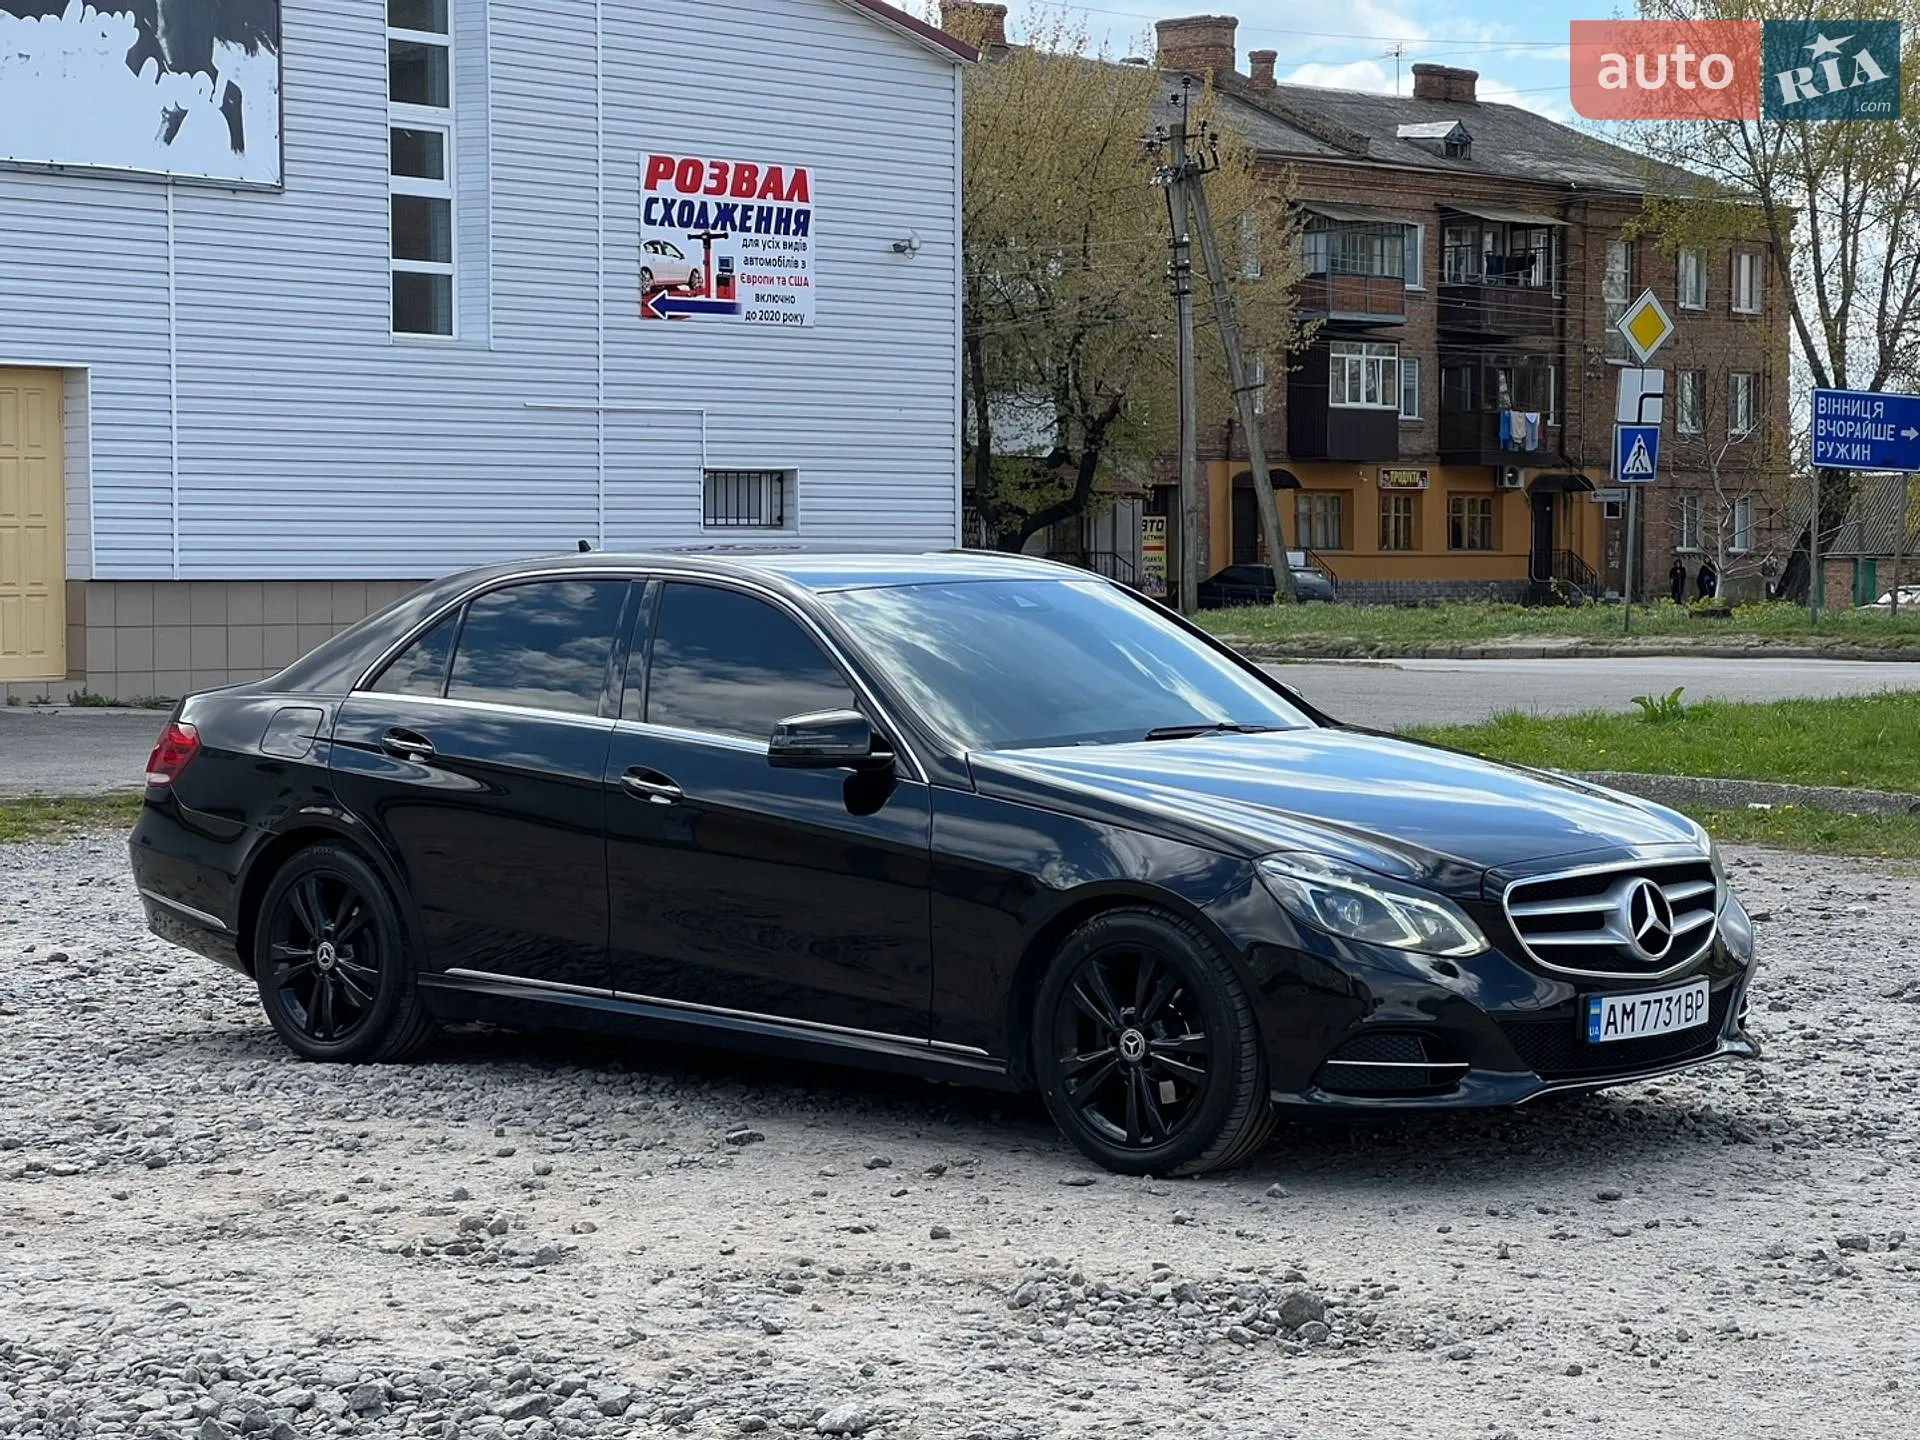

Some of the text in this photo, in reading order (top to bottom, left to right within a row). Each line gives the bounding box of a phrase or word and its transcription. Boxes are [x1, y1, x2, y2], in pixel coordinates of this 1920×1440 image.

[643, 154, 811, 203] РОЗВАЛ
[643, 197, 812, 237] СХОДЖЕННЯ
[741, 237, 808, 252] для усіх видів
[743, 256, 807, 269] автомобілів з
[740, 272, 810, 287] Європи та США
[754, 293, 796, 305] включно
[745, 310, 806, 325] до 2020 року
[1817, 396, 1884, 420] ВІННИЦЯ
[1816, 419, 1896, 441] ВЧОРАЙШЕ
[1816, 441, 1871, 461] РУЖИН
